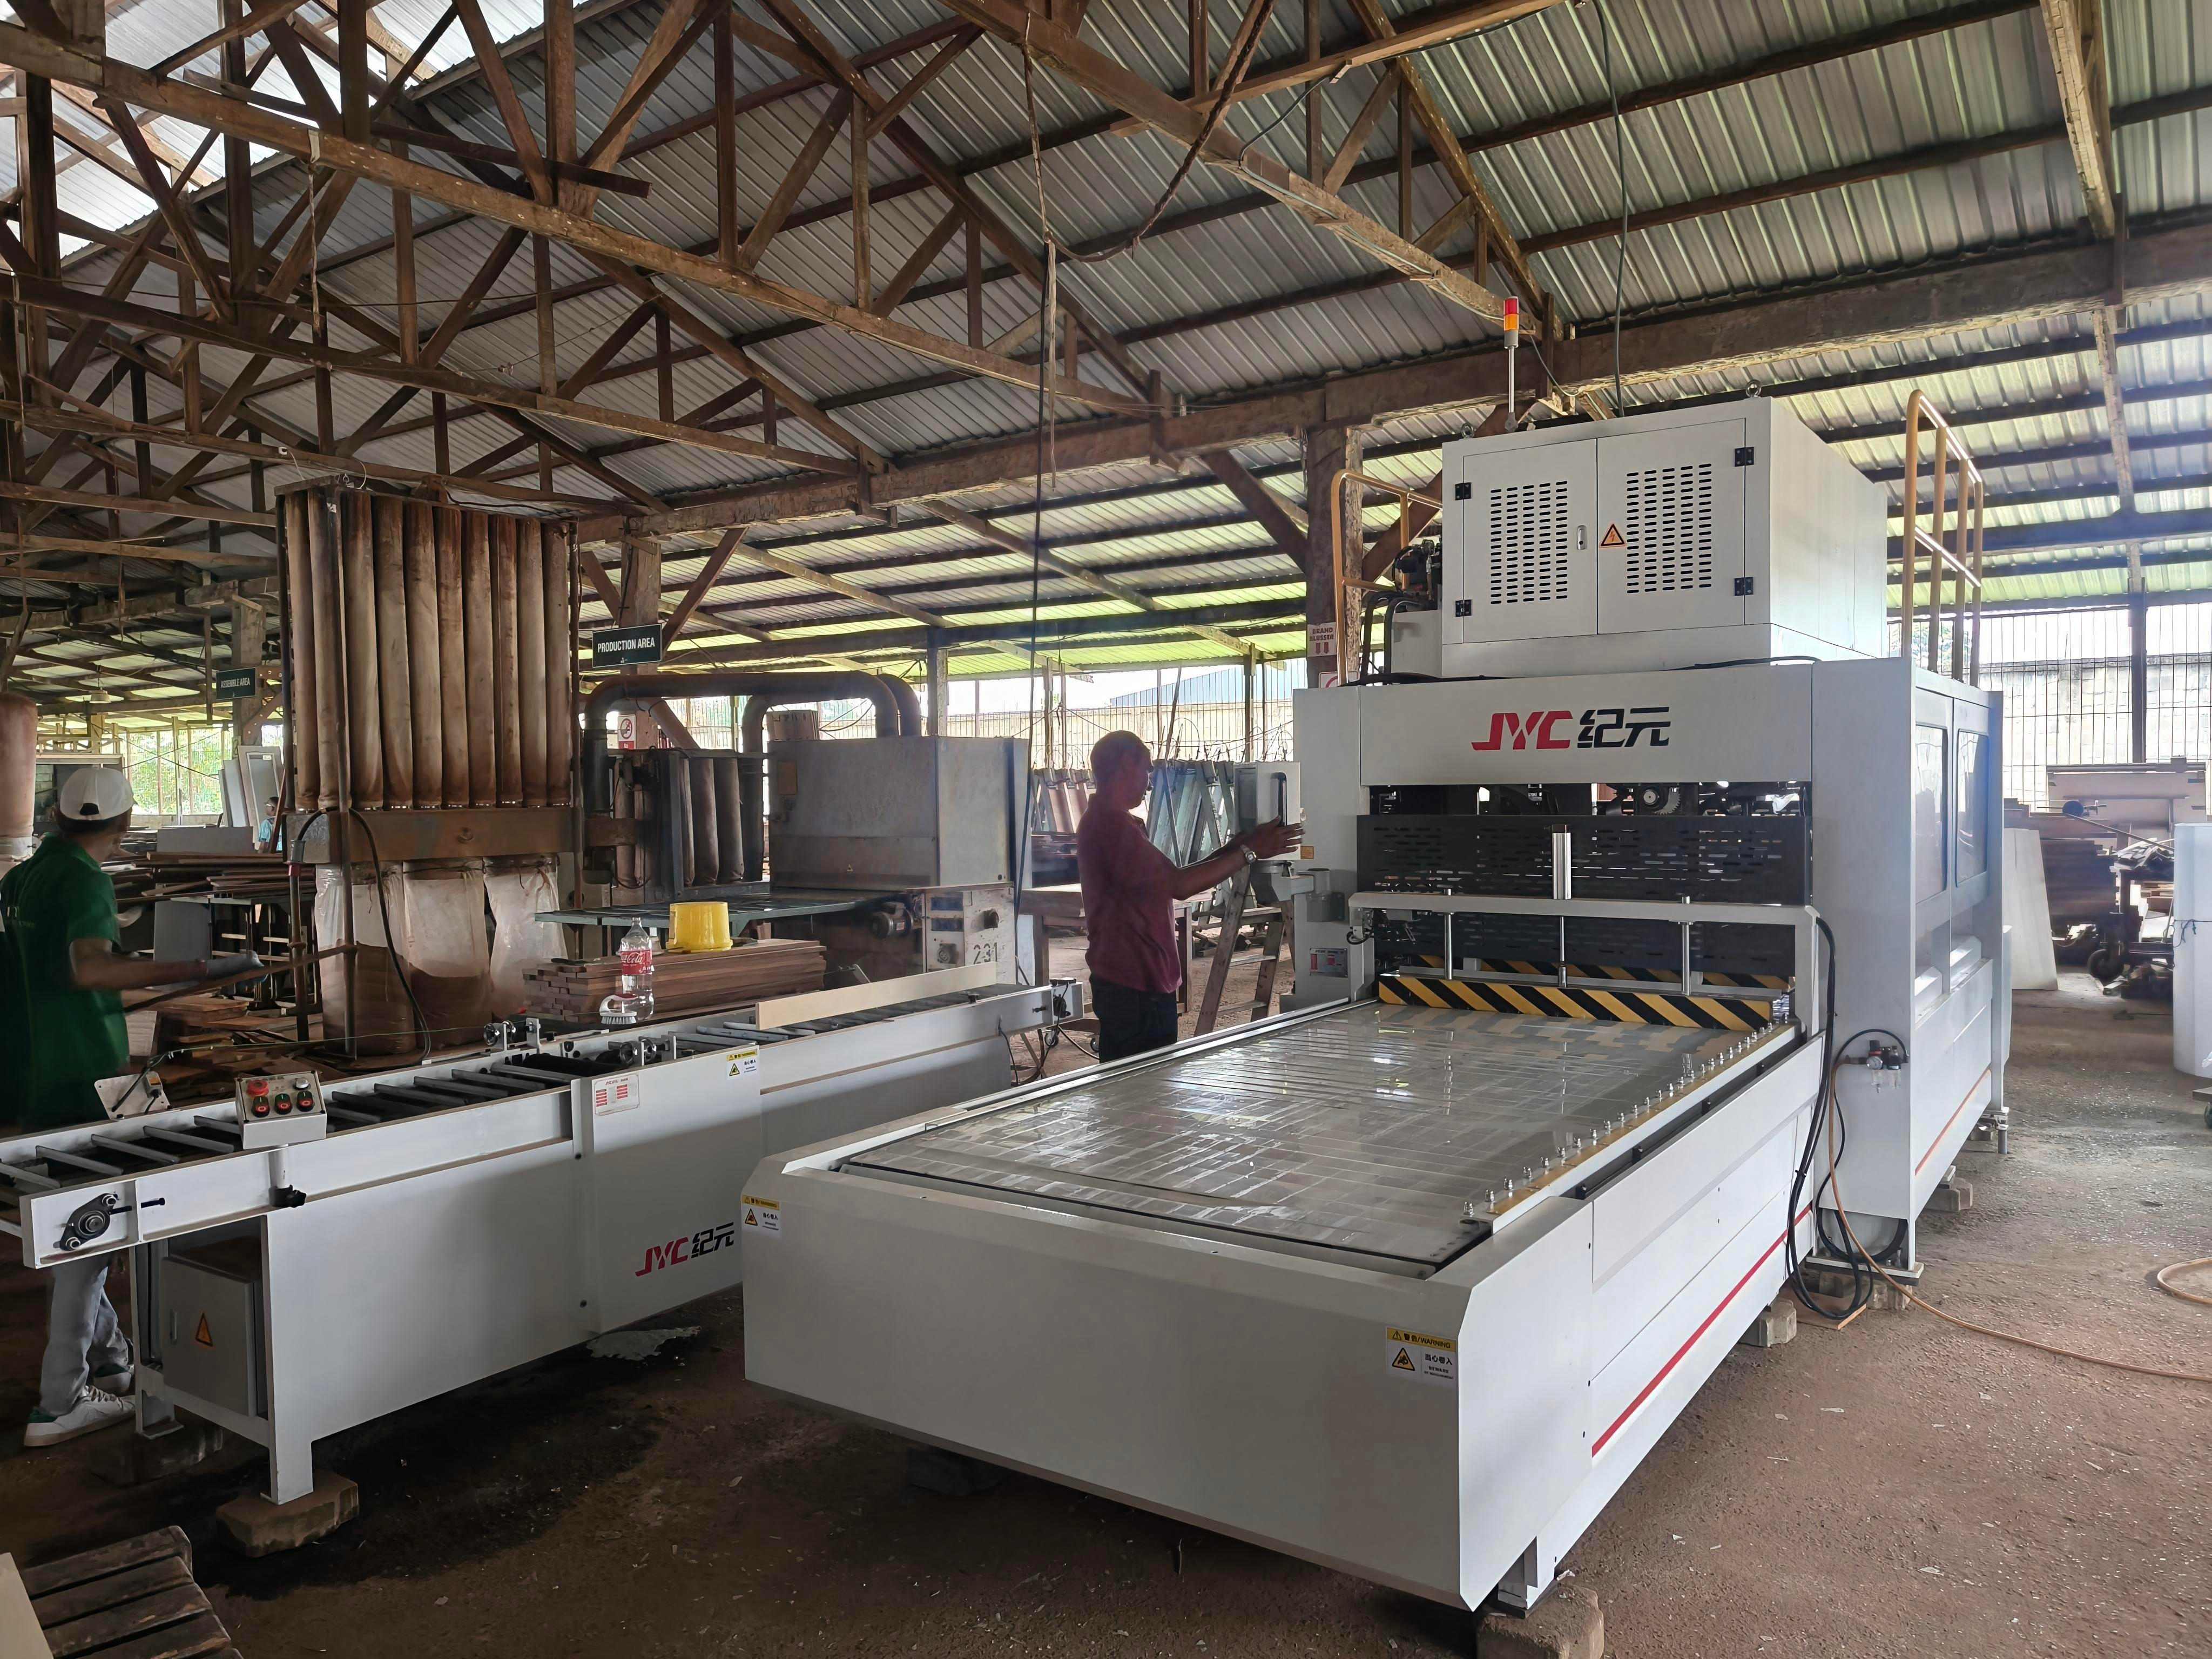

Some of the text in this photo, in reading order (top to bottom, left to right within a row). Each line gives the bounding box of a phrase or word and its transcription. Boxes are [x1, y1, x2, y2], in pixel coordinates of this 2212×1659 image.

[597, 637, 656, 653] PRODUCTION AREA
[1471, 706, 1671, 751] JYC 纪元
[635, 1222, 734, 1277] JYC 纪元
